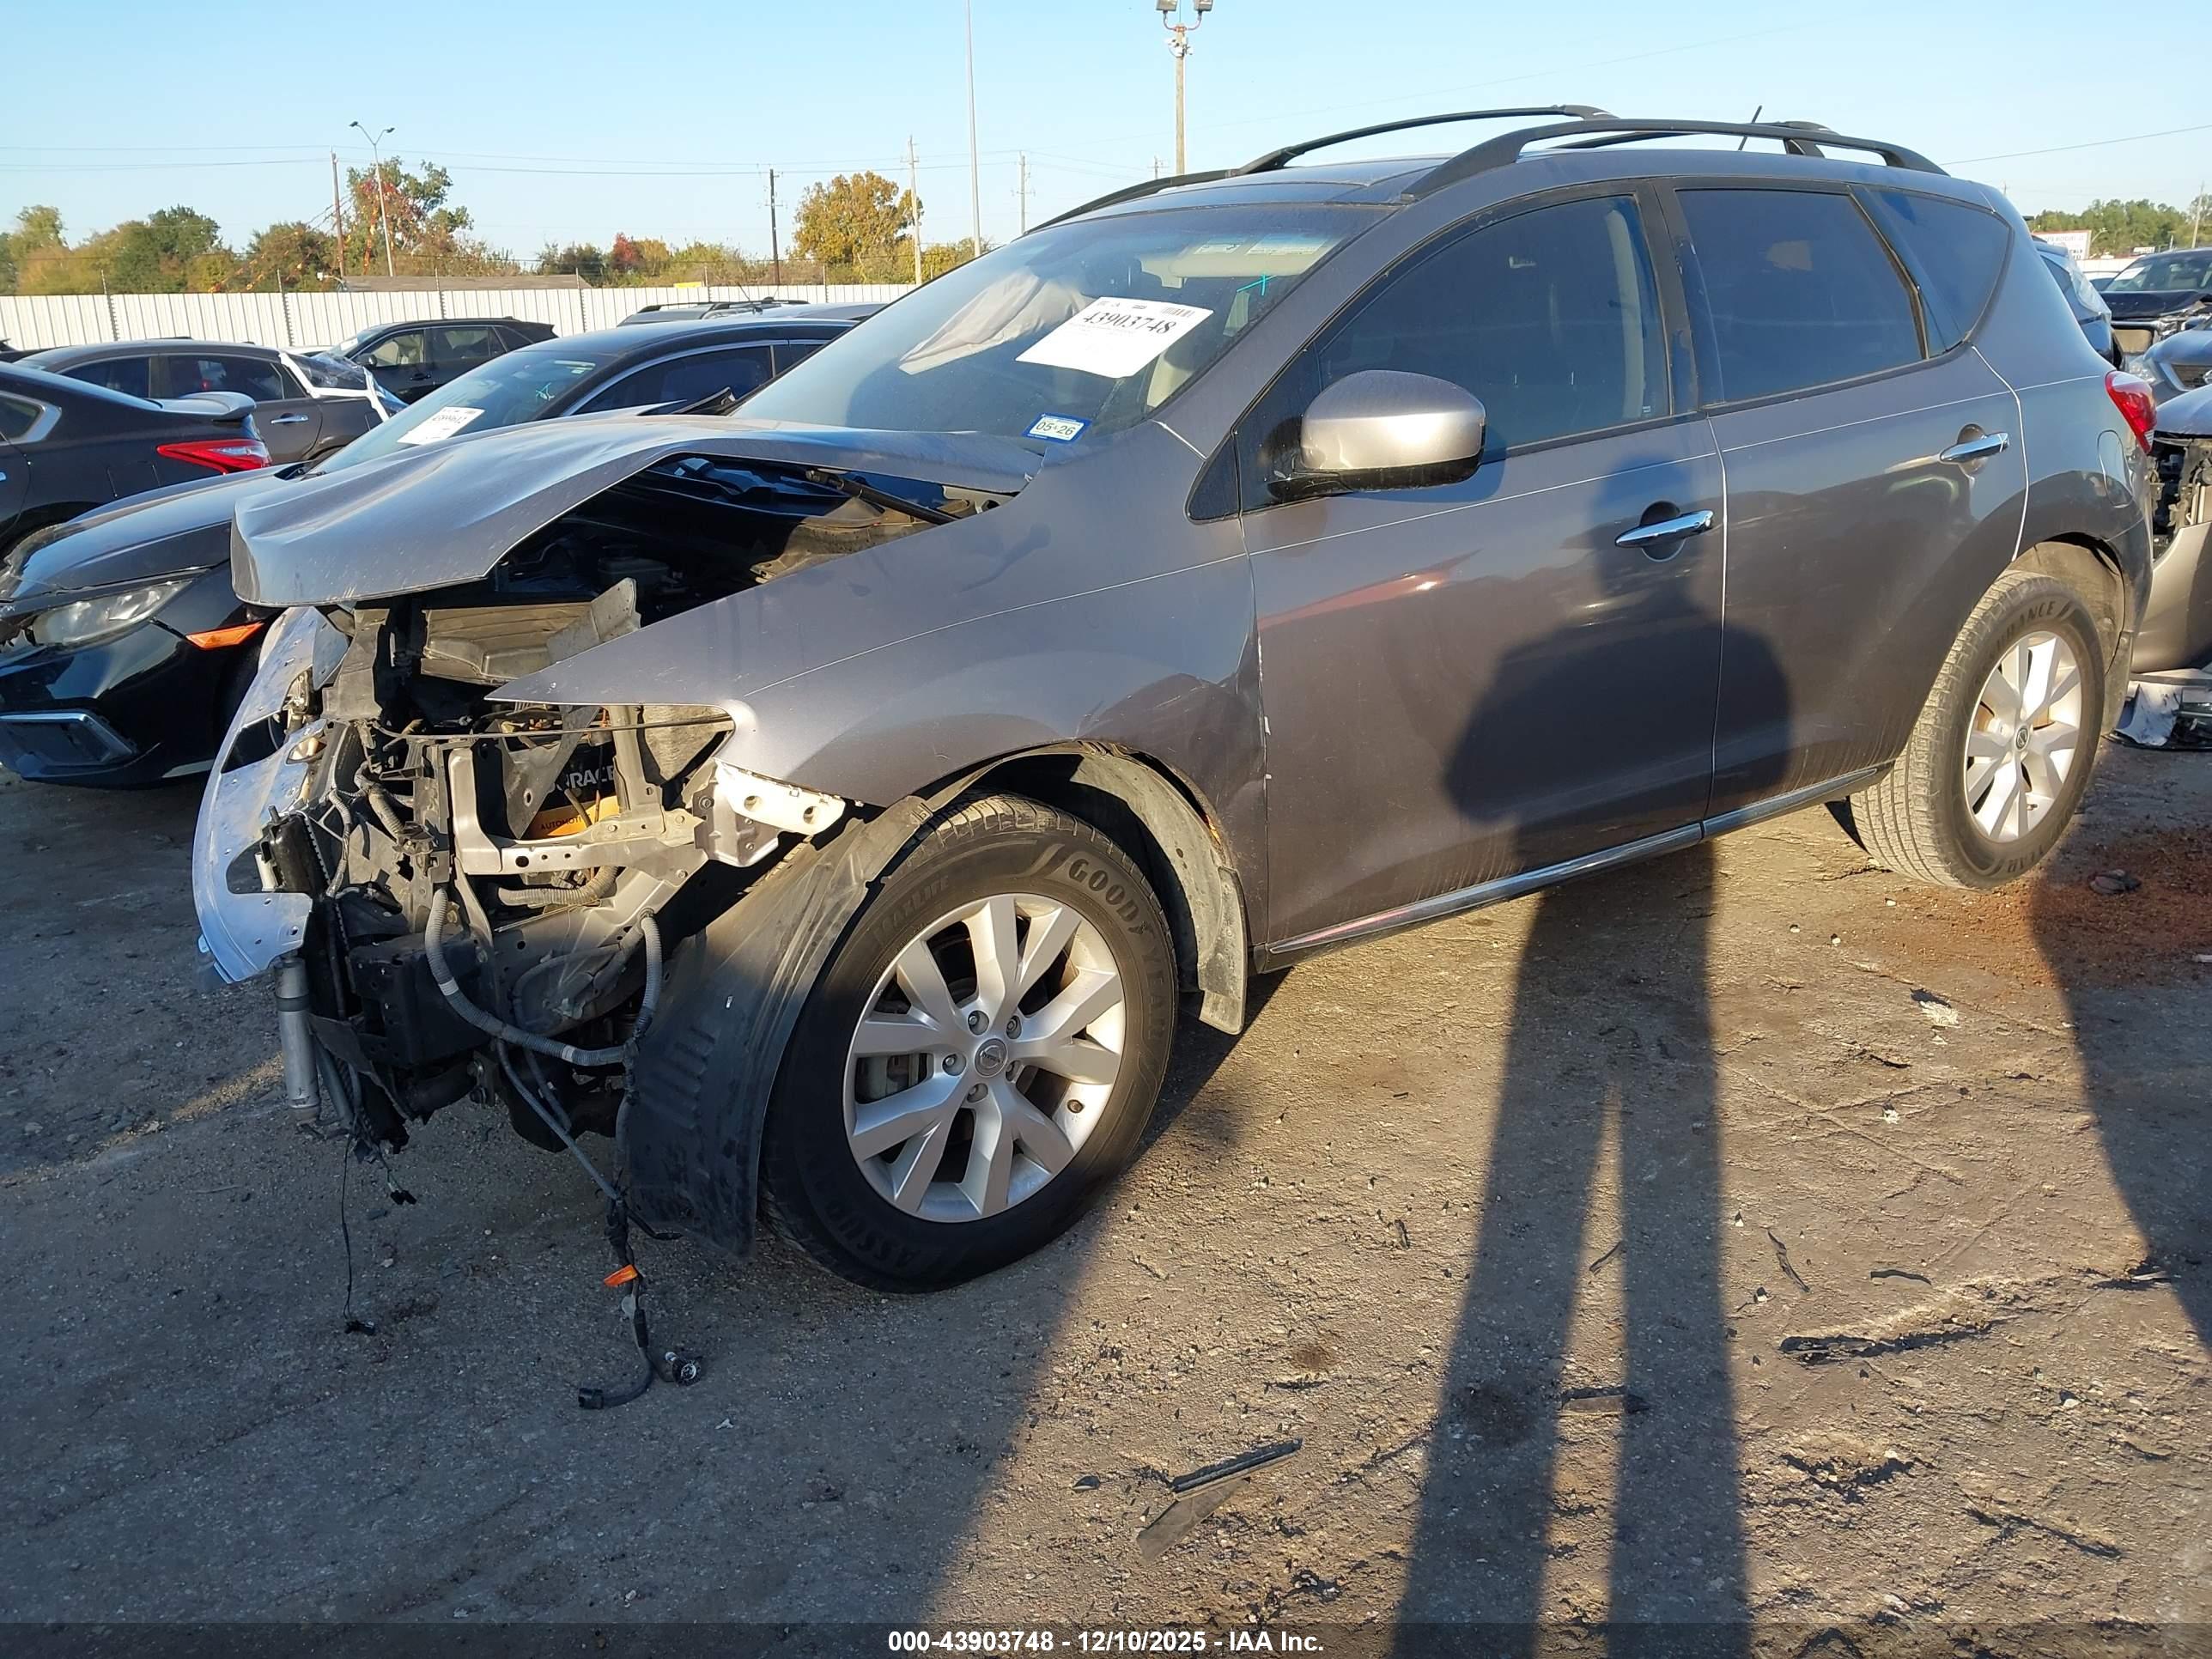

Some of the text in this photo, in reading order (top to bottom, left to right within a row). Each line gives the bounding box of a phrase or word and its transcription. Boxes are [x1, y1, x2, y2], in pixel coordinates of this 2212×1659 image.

[1083, 310, 1177, 335] 43903748
[1036, 422, 1076, 435] 05 26
[540, 814, 591, 830] AUTOMOTI
